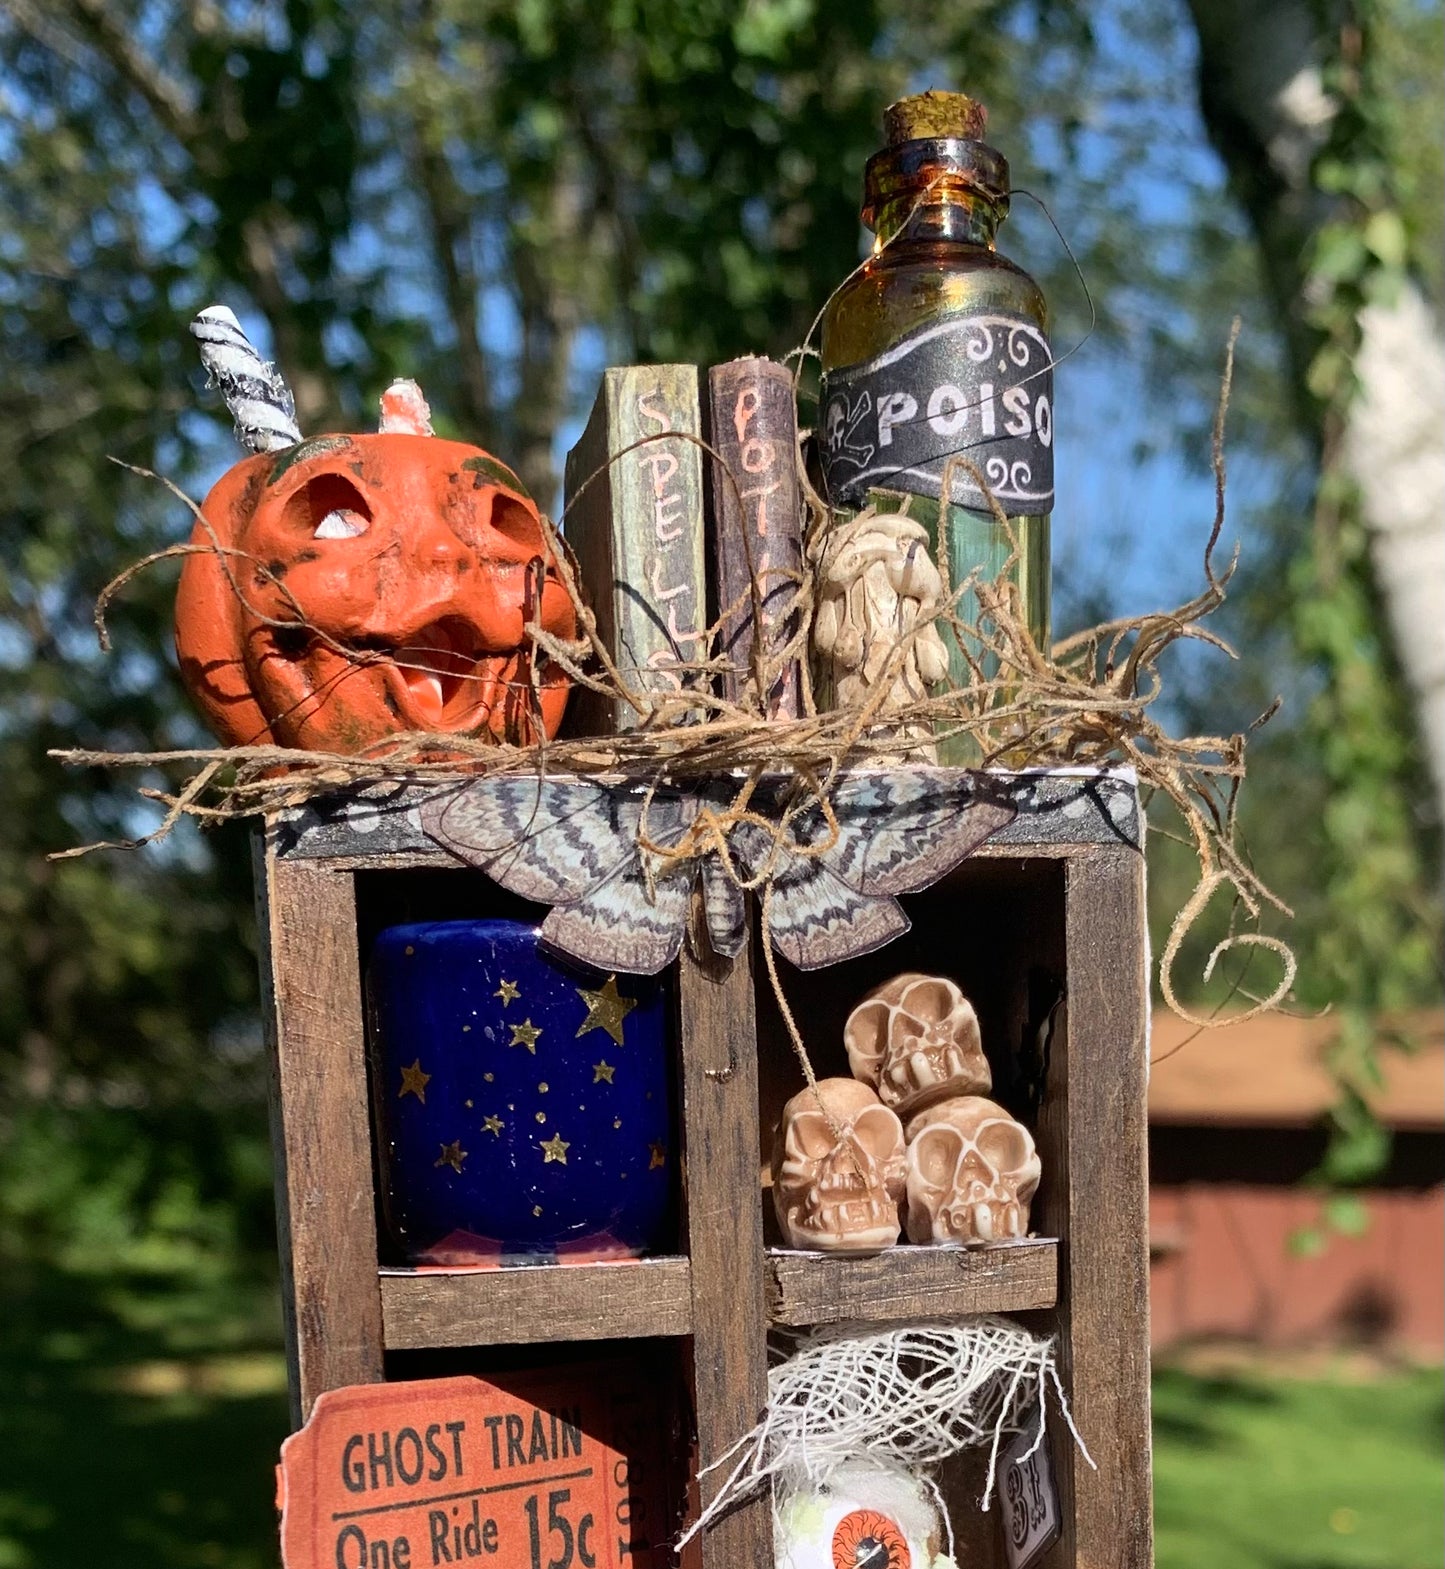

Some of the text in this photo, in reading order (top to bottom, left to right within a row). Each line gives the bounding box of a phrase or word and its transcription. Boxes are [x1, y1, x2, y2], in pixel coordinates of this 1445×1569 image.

[637, 389, 702, 702] SPELLS
[341, 1405, 583, 1493] GHOST TRAIN
[429, 1500, 499, 1566] Ride
